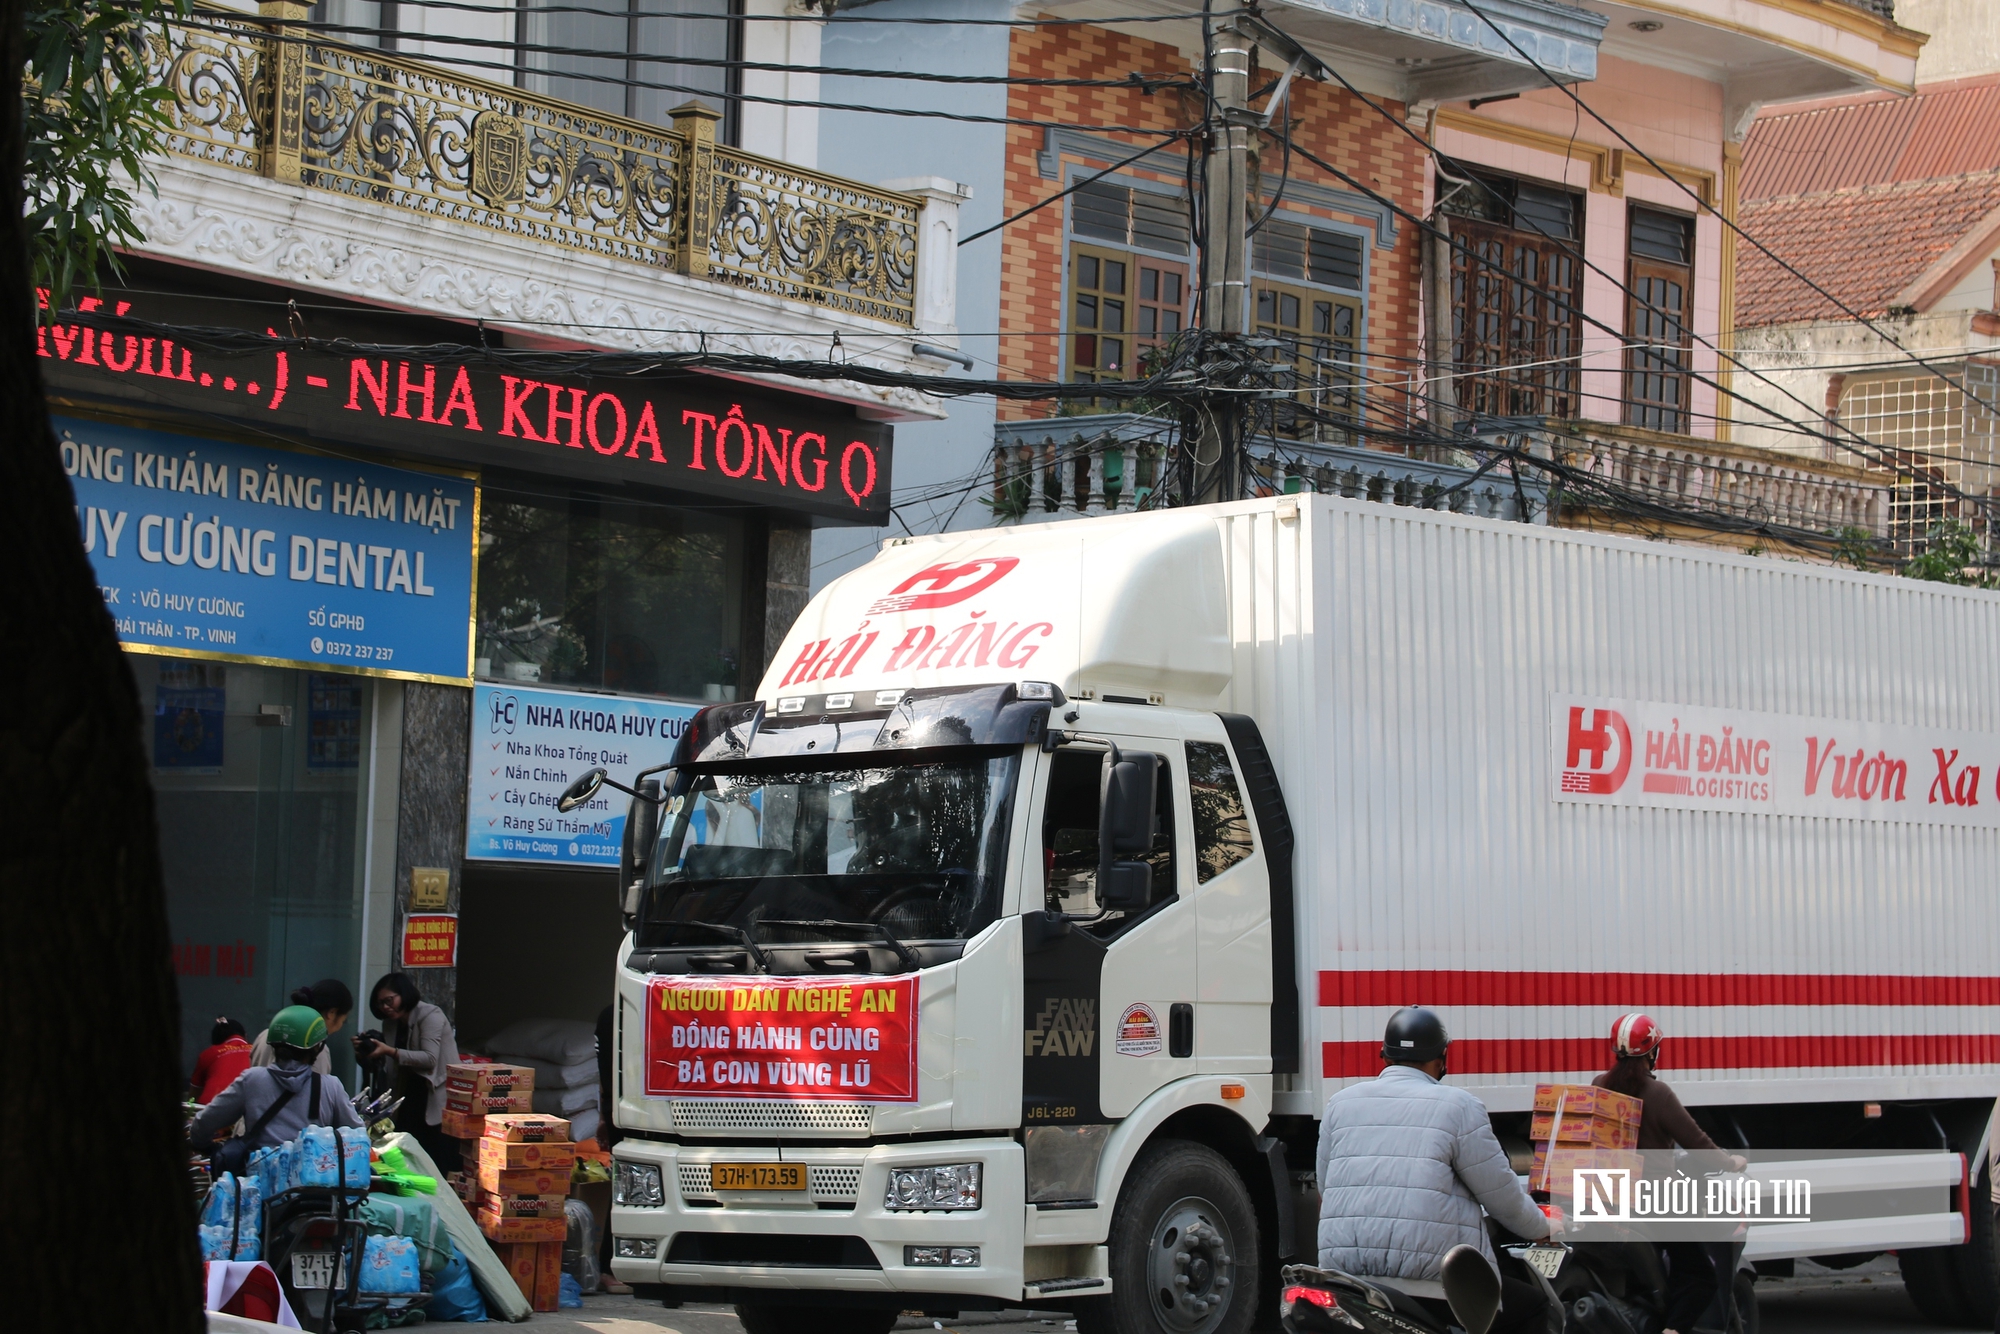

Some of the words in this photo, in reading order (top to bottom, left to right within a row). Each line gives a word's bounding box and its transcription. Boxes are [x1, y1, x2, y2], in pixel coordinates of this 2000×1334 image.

[344, 358, 483, 432] NHA
[498, 375, 667, 464] KHOA
[60, 430, 123, 483] ÒNG
[134, 450, 228, 499] KHÁM
[239, 463, 322, 511] RĂNG
[332, 476, 396, 521] HÀM
[404, 488, 461, 534] MẶT
[74, 505, 128, 557] UY
[139, 512, 276, 577] CƯƠNG
[289, 535, 434, 596] DENTAL
[96, 585, 120, 604] CK
[140, 588, 161, 608] VÕ
[165, 593, 194, 612] HUY
[198, 597, 244, 618] CƯƠNG
[112, 616, 136, 634] HÁI
[139, 619, 173, 638] THÂN
[208, 628, 236, 644] VINH
[309, 605, 326, 626] SỐ
[329, 613, 365, 631] GPHĐ
[326, 641, 352, 657] 0372
[355, 644, 373, 658] 237
[376, 646, 394, 661] 237
[778, 620, 880, 689] HẢI
[882, 610, 1053, 673] ĐĂNG
[526, 705, 564, 728] NHA
[570, 709, 617, 734] KHOA
[622, 715, 656, 737] HUY
[507, 742, 531, 756] Nha
[535, 744, 565, 759] Khoa
[568, 745, 597, 765] Tổng
[600, 750, 628, 765] Quát
[1645, 718, 1691, 771] HẢI
[1697, 726, 1770, 776] ĐĂNG
[1804, 736, 1907, 803] Vươn
[1928, 747, 1980, 807] Xa
[1687, 776, 1769, 801] LOGISTICS
[503, 816, 534, 834] Răng
[538, 818, 553, 832] Sứ
[556, 817, 590, 834] Thẩm
[593, 822, 612, 839] Mỹ
[515, 840, 531, 854] Huy
[216, 939, 257, 984] MẶT
[786, 984, 852, 1018] NGHỆ
[860, 988, 896, 1013] AN
[1046, 998, 1095, 1018] FAW
[672, 1018, 730, 1049] ĐỒNG
[736, 1021, 802, 1050] HÀNH
[809, 1022, 880, 1051] CÙNG
[1036, 1012, 1095, 1034] FAW
[1025, 1030, 1095, 1056] FAW
[486, 1074, 520, 1086] KOKOMI
[678, 1056, 706, 1083] BÀ
[713, 1060, 760, 1085] CON
[766, 1057, 832, 1086] VÙNG
[839, 1059, 871, 1087] LŨ
[481, 1096, 517, 1108] KOKOMI
[1027, 1107, 1076, 1119] J6L-220
[516, 1125, 554, 1136] KOKOMI
[719, 1167, 798, 1186] 37H-173.59
[508, 1200, 548, 1210] KOKOMI
[1529, 1250, 1558, 1263] 76-C1
[302, 1270, 329, 1286] 111
